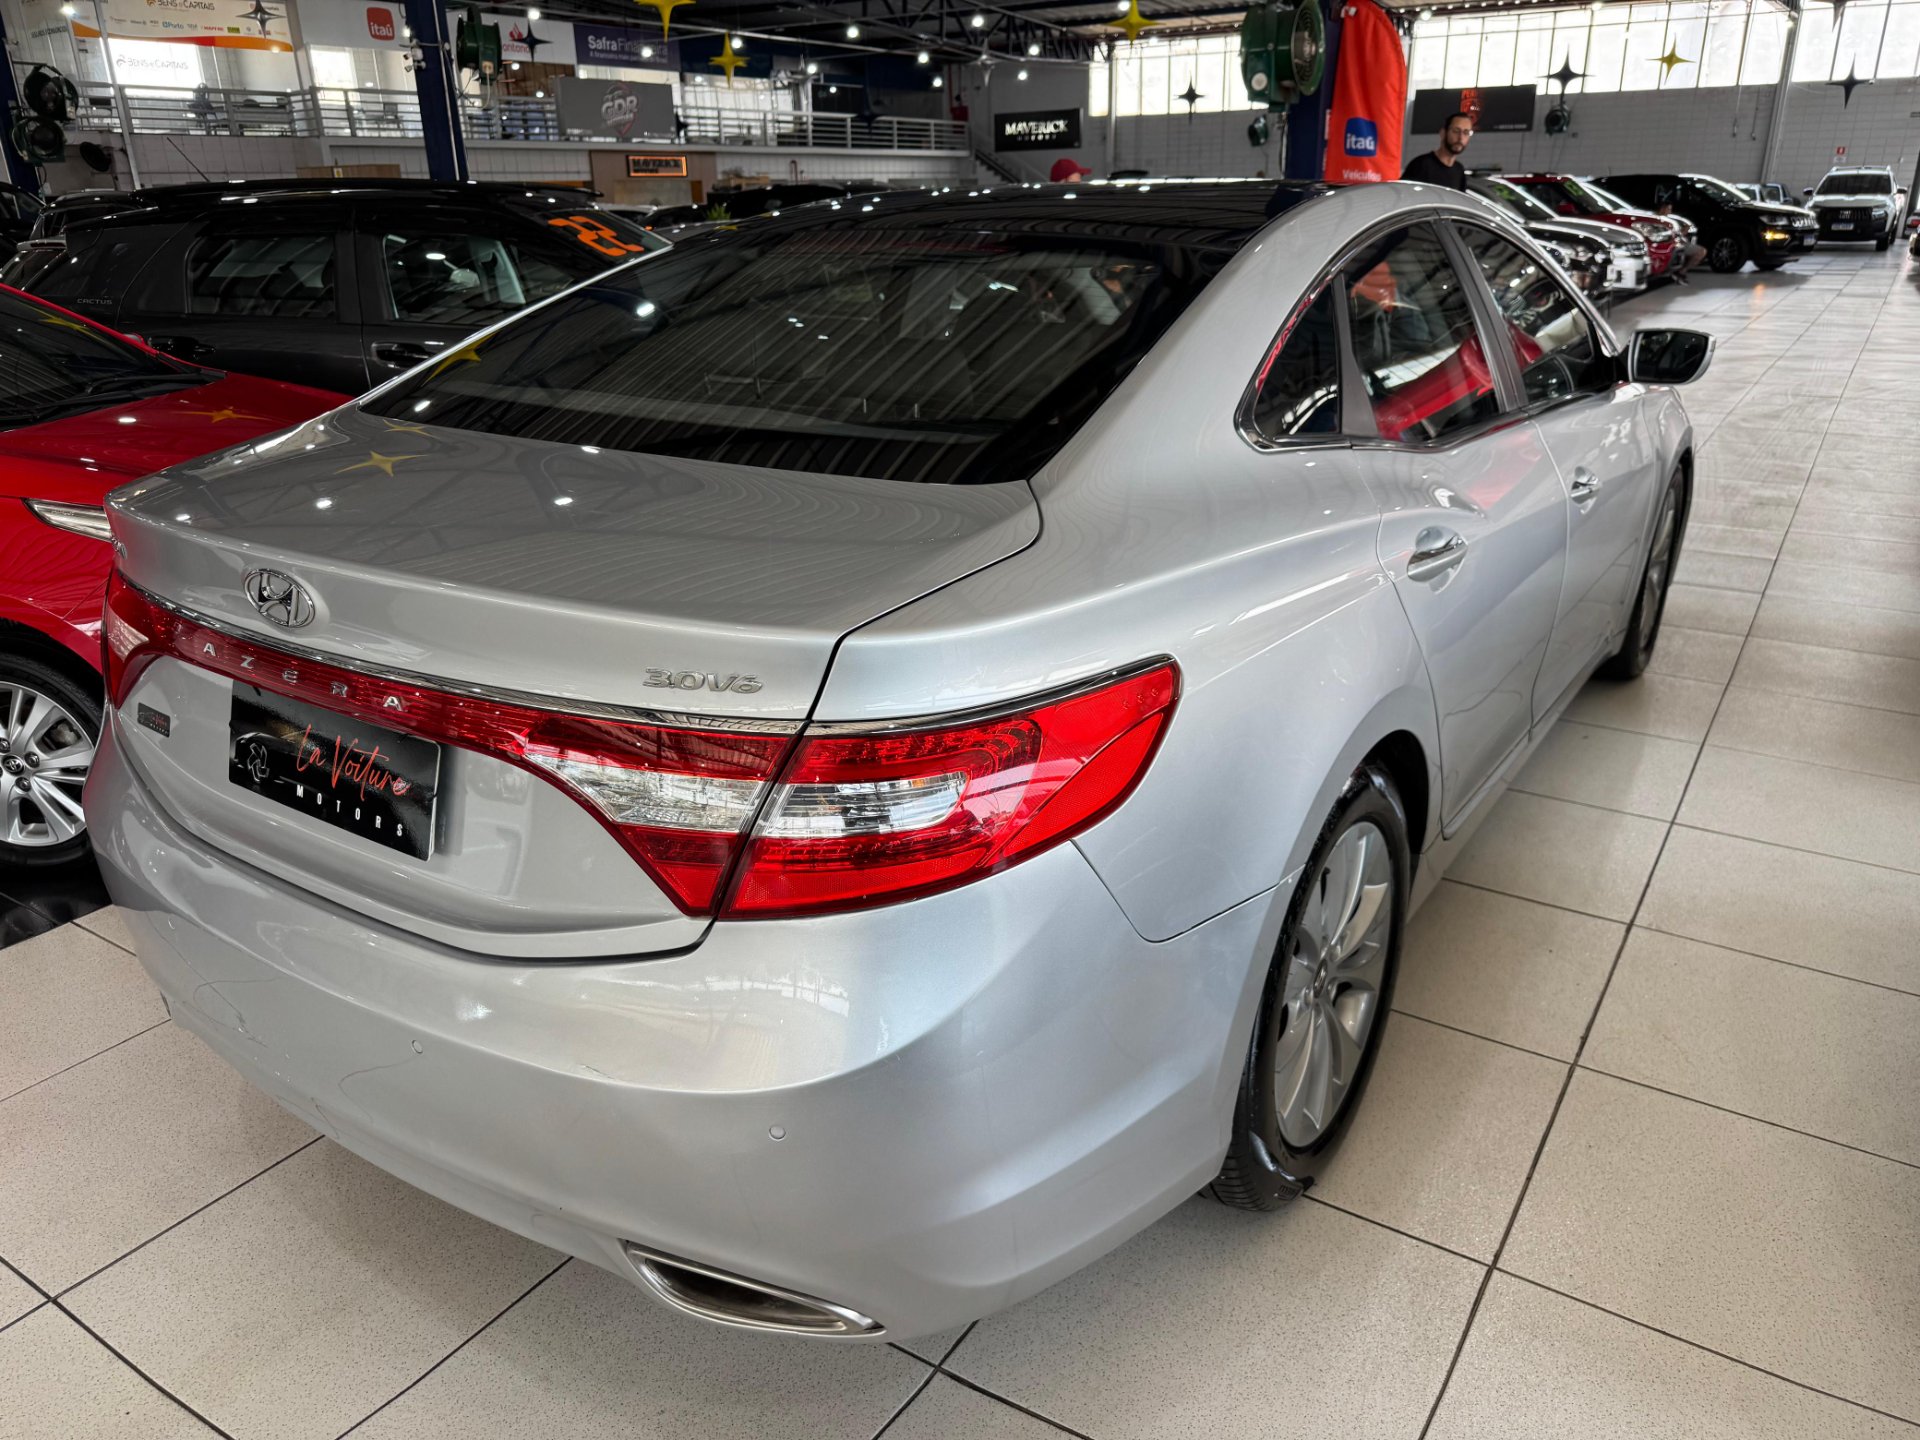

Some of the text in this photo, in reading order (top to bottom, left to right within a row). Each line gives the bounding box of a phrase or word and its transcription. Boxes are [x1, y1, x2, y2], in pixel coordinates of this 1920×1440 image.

[369, 21, 394, 37] itaú
[76, 297, 113, 305] CACTUS
[202, 641, 407, 713] AZERA
[331, 734, 411, 802] Voiture
[296, 783, 404, 838] MOTORS
